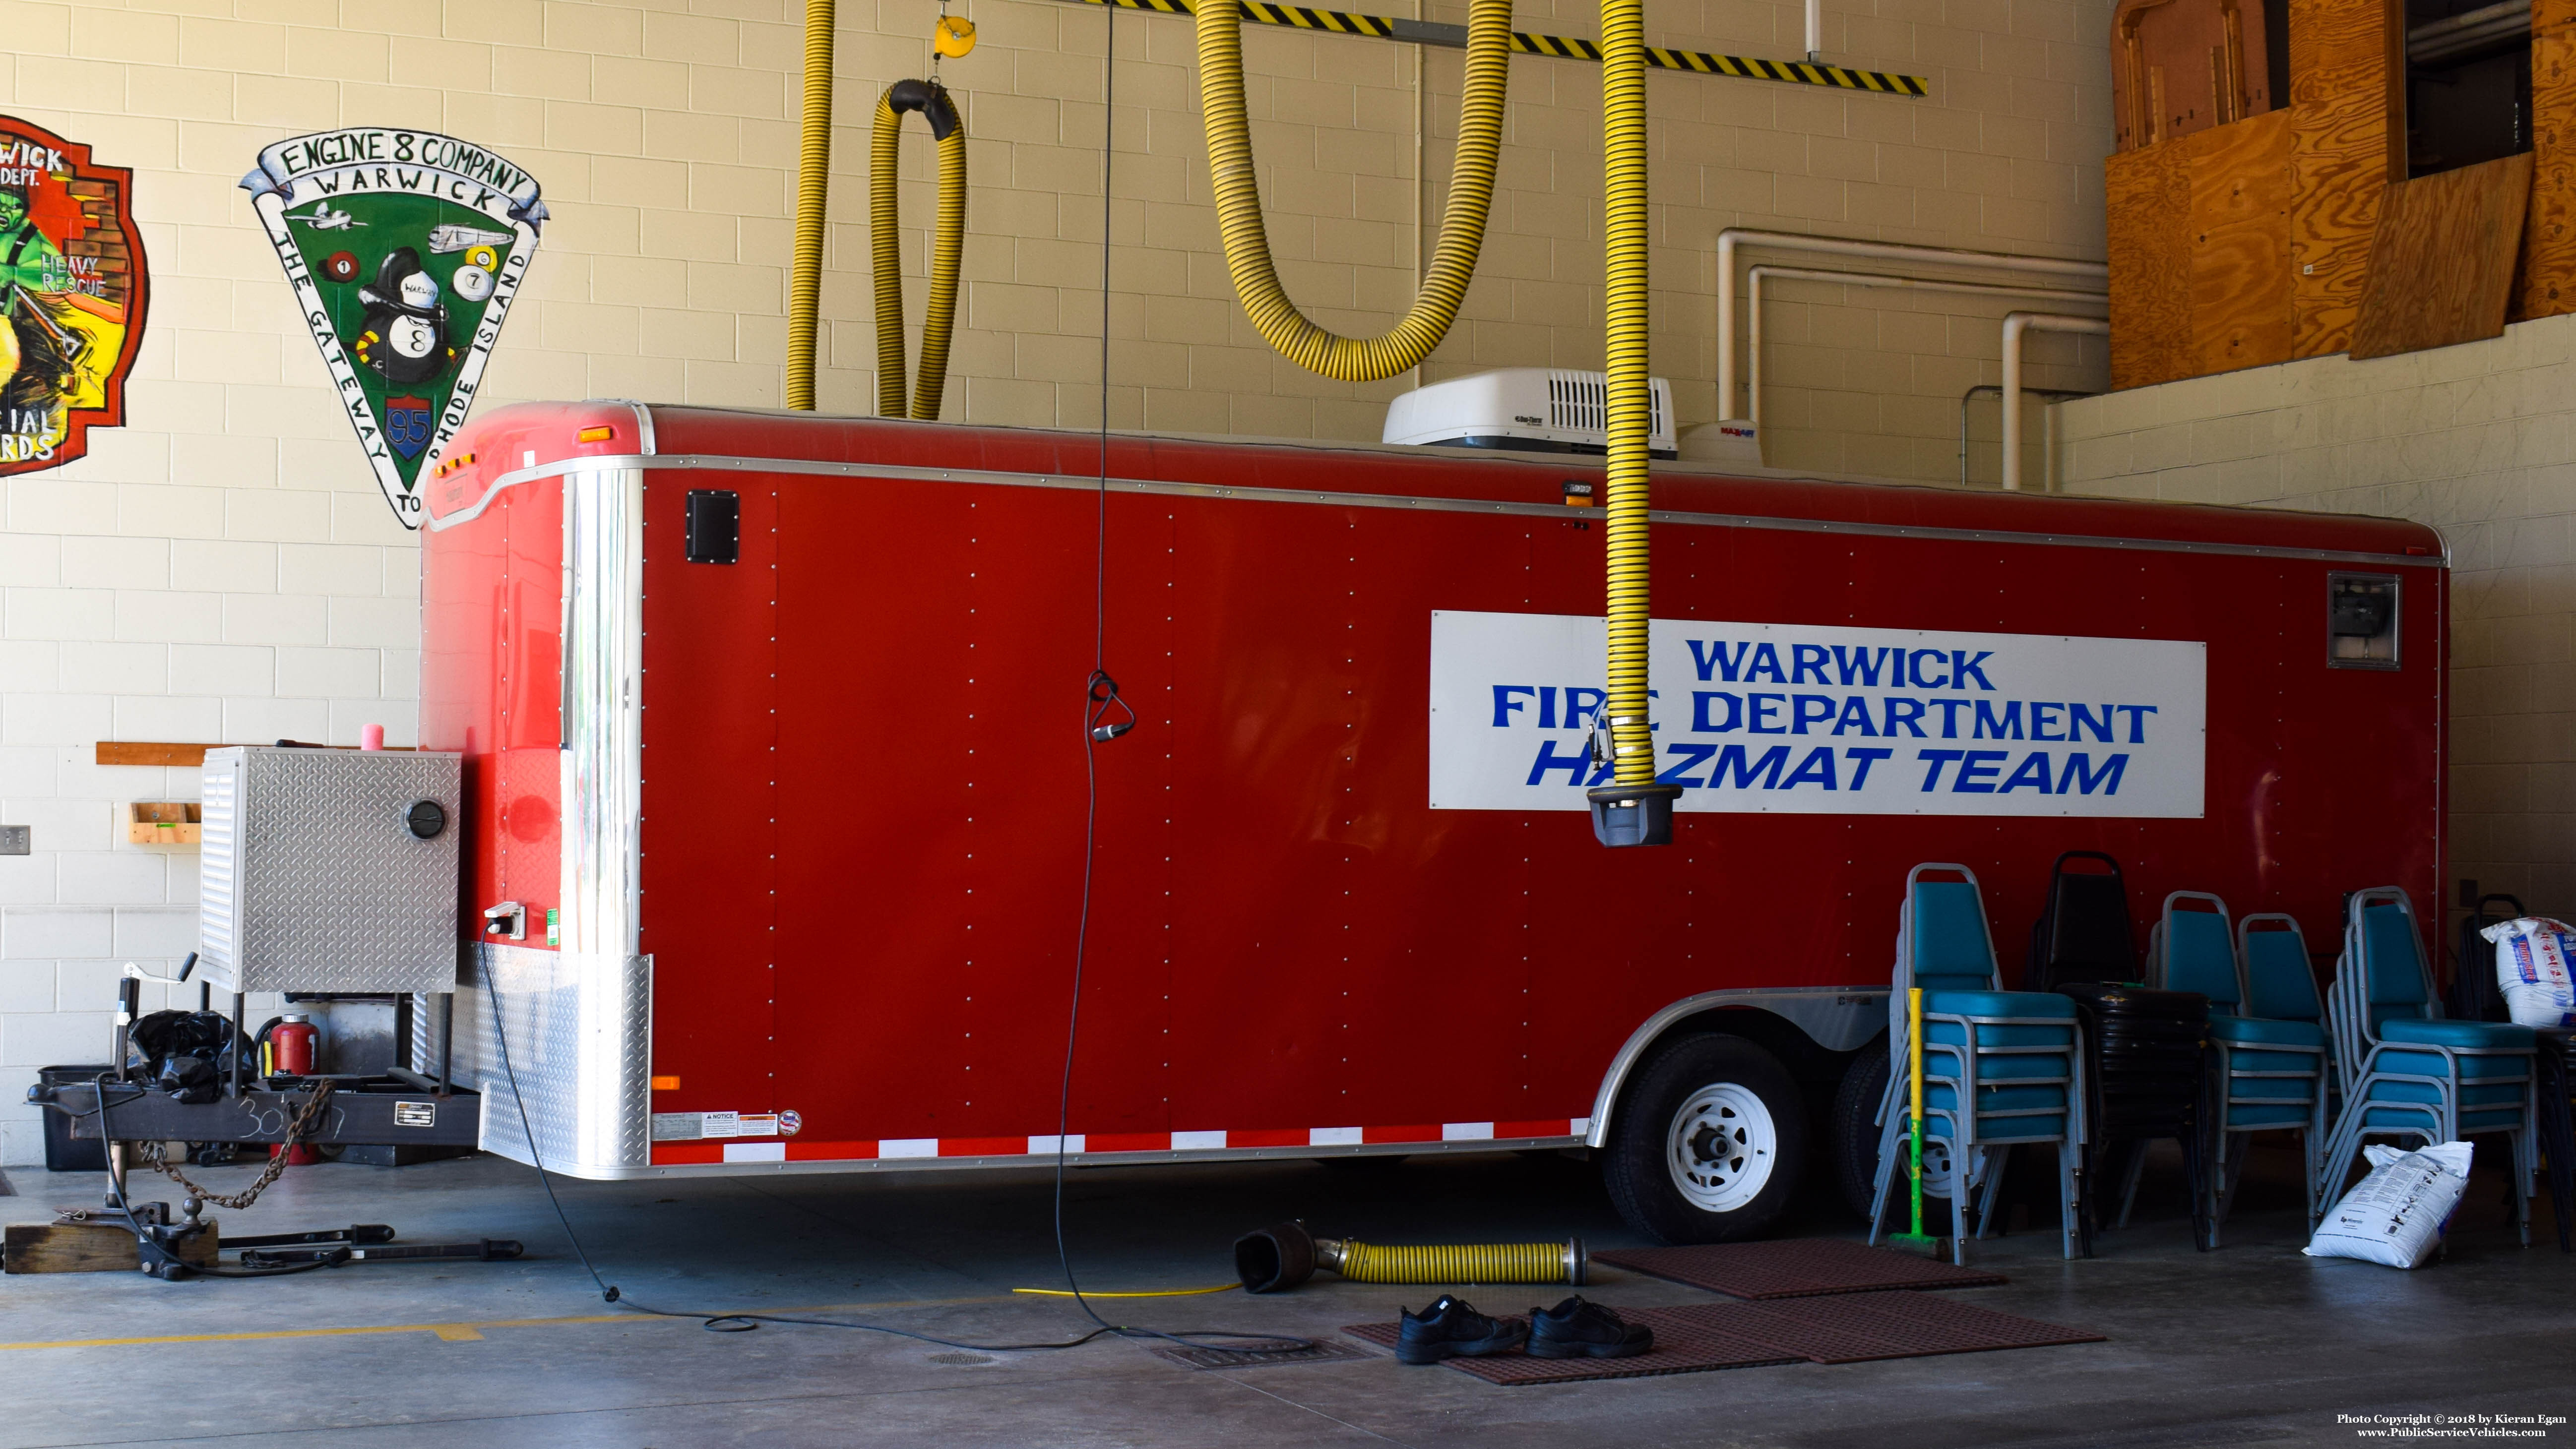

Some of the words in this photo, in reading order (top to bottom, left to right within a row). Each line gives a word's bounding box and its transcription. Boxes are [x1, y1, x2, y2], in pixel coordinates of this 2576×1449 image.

[0, 168, 40, 186] DEPT.
[280, 133, 385, 175] ENGINE
[394, 133, 415, 161] 8
[422, 138, 527, 194] COMPANY
[313, 168, 496, 210] WARWICK
[41, 253, 98, 276] HEAVY
[341, 262, 346, 272] 1
[481, 252, 487, 263] 6
[43, 273, 107, 297] RESCUE
[470, 275, 480, 286] 7
[472, 254, 525, 353] ISLAND
[277, 232, 312, 292] THE
[310, 310, 388, 458] GATEWAY
[411, 330, 426, 352] 8
[388, 410, 429, 444] 95
[396, 494, 421, 512] TO
[1686, 640, 1997, 691] WARWICK
[1691, 691, 2158, 743] DEPARTMENT
[1917, 749, 2130, 795] TEAM
